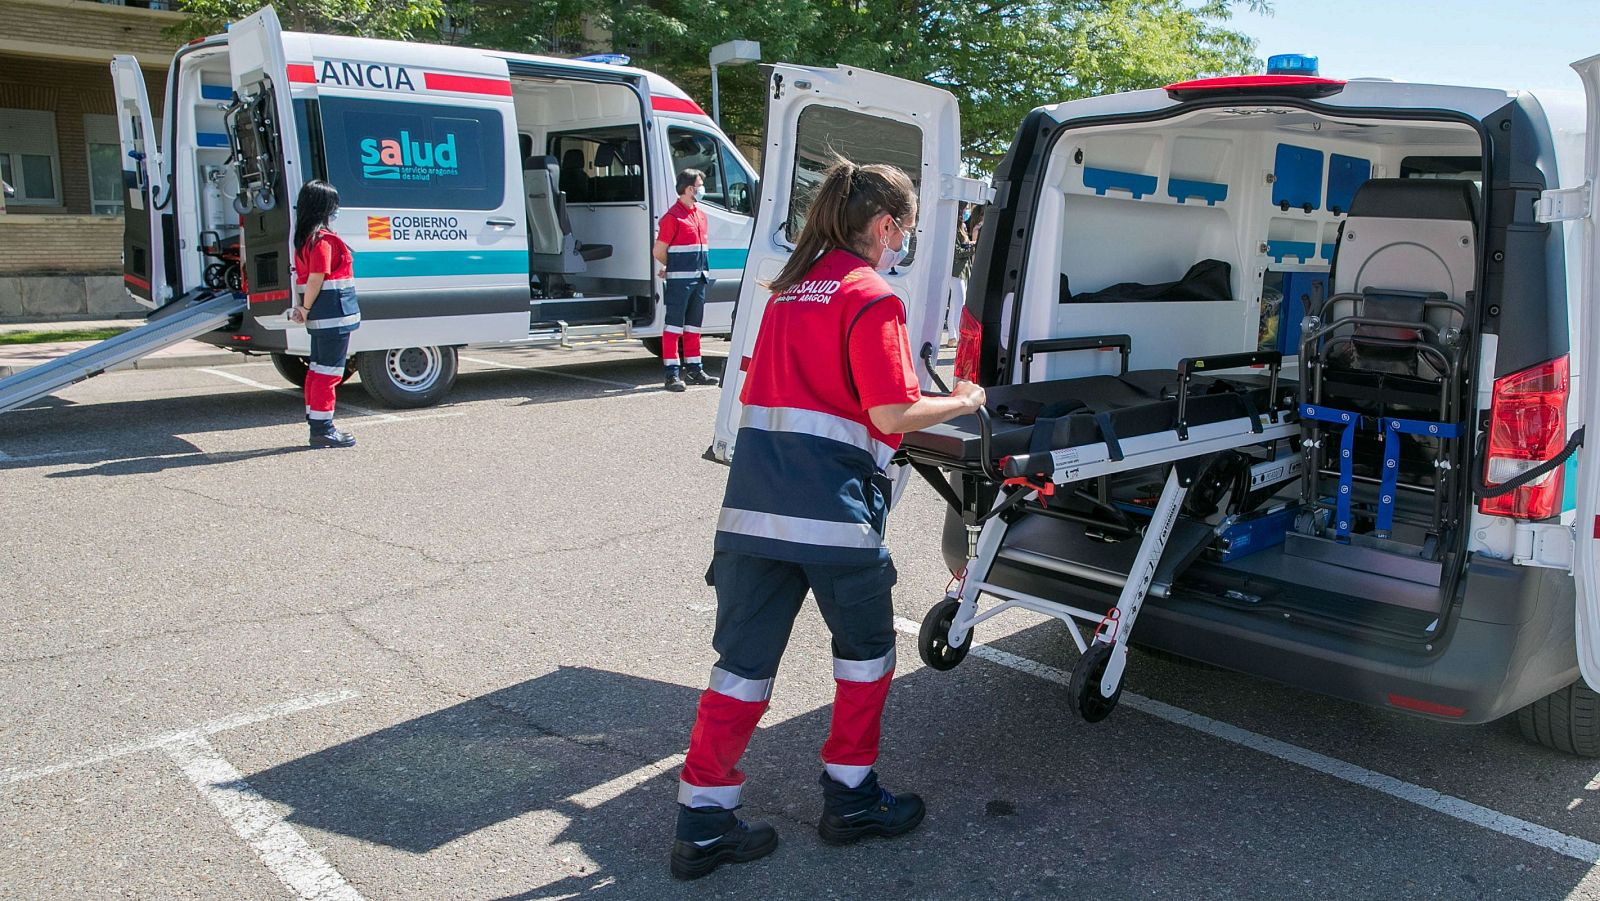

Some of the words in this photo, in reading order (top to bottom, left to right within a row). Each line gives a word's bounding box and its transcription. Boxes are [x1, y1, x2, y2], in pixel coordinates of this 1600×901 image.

[316, 60, 415, 91] ANCIA
[361, 131, 458, 168] salud
[401, 166, 427, 174] servicio
[392, 216, 458, 228] GOBIERNO
[393, 229, 410, 240] DE
[415, 229, 467, 240] ARAGON
[798, 294, 831, 304] ARAGON
